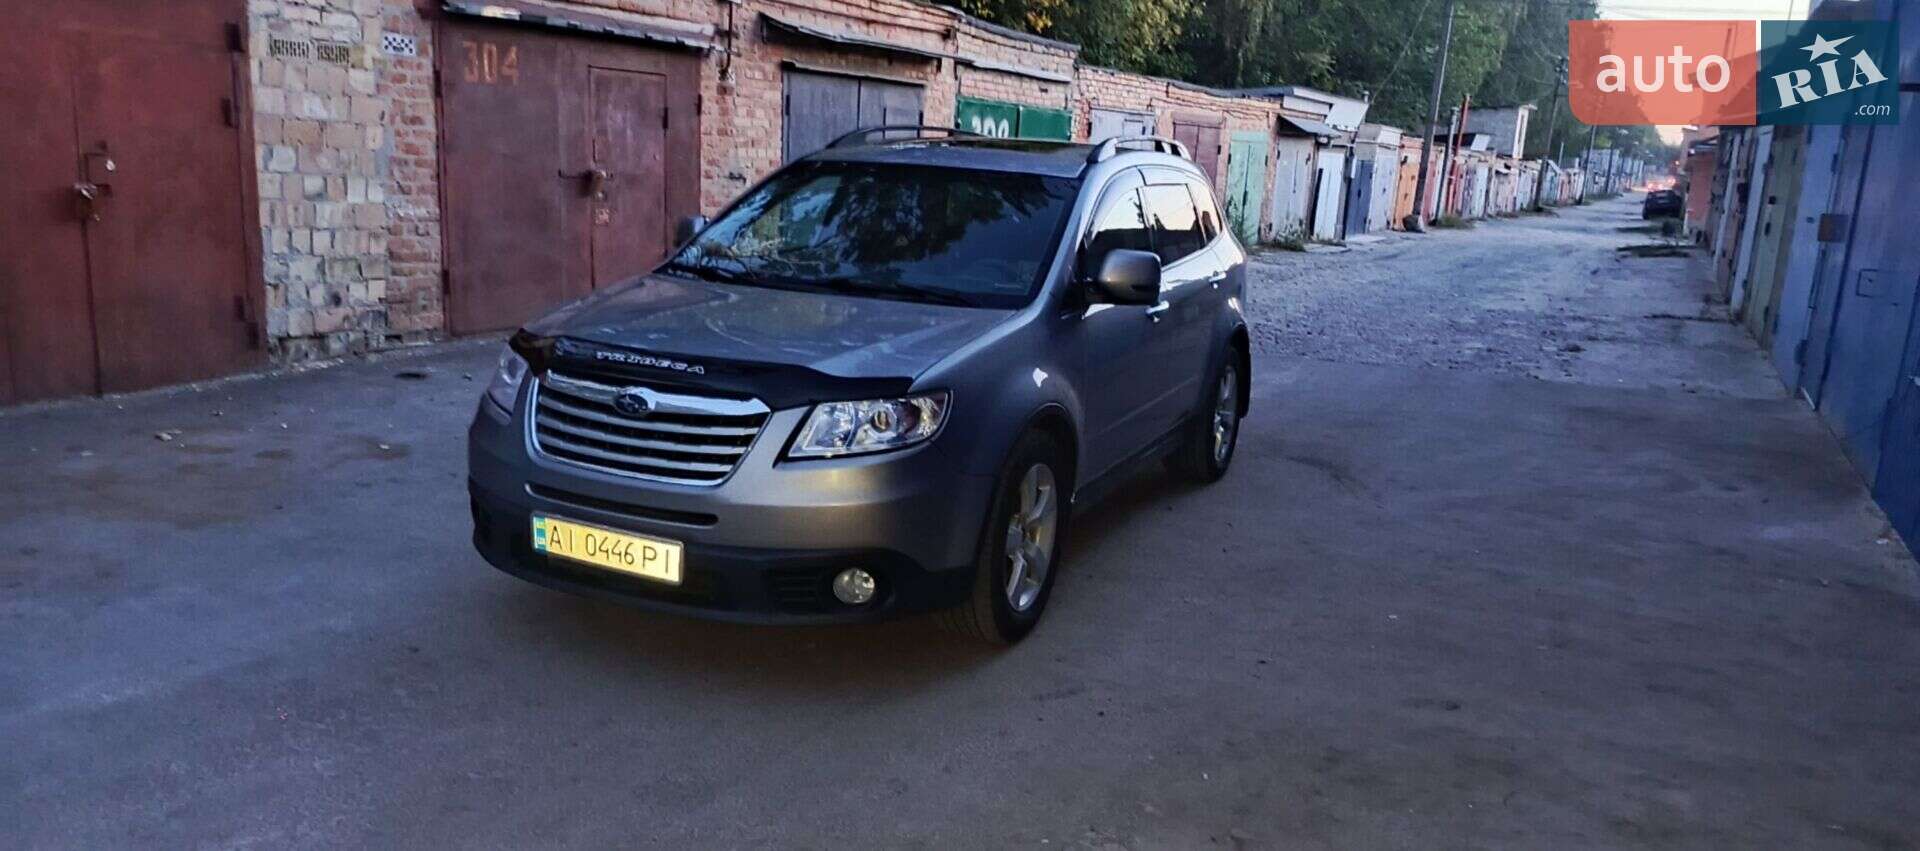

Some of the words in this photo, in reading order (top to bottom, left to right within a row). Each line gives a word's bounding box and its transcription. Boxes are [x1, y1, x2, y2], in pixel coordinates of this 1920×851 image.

[462, 41, 519, 86] 304
[549, 525, 574, 553] AI
[585, 532, 635, 566] 0446
[642, 545, 670, 575] PI
